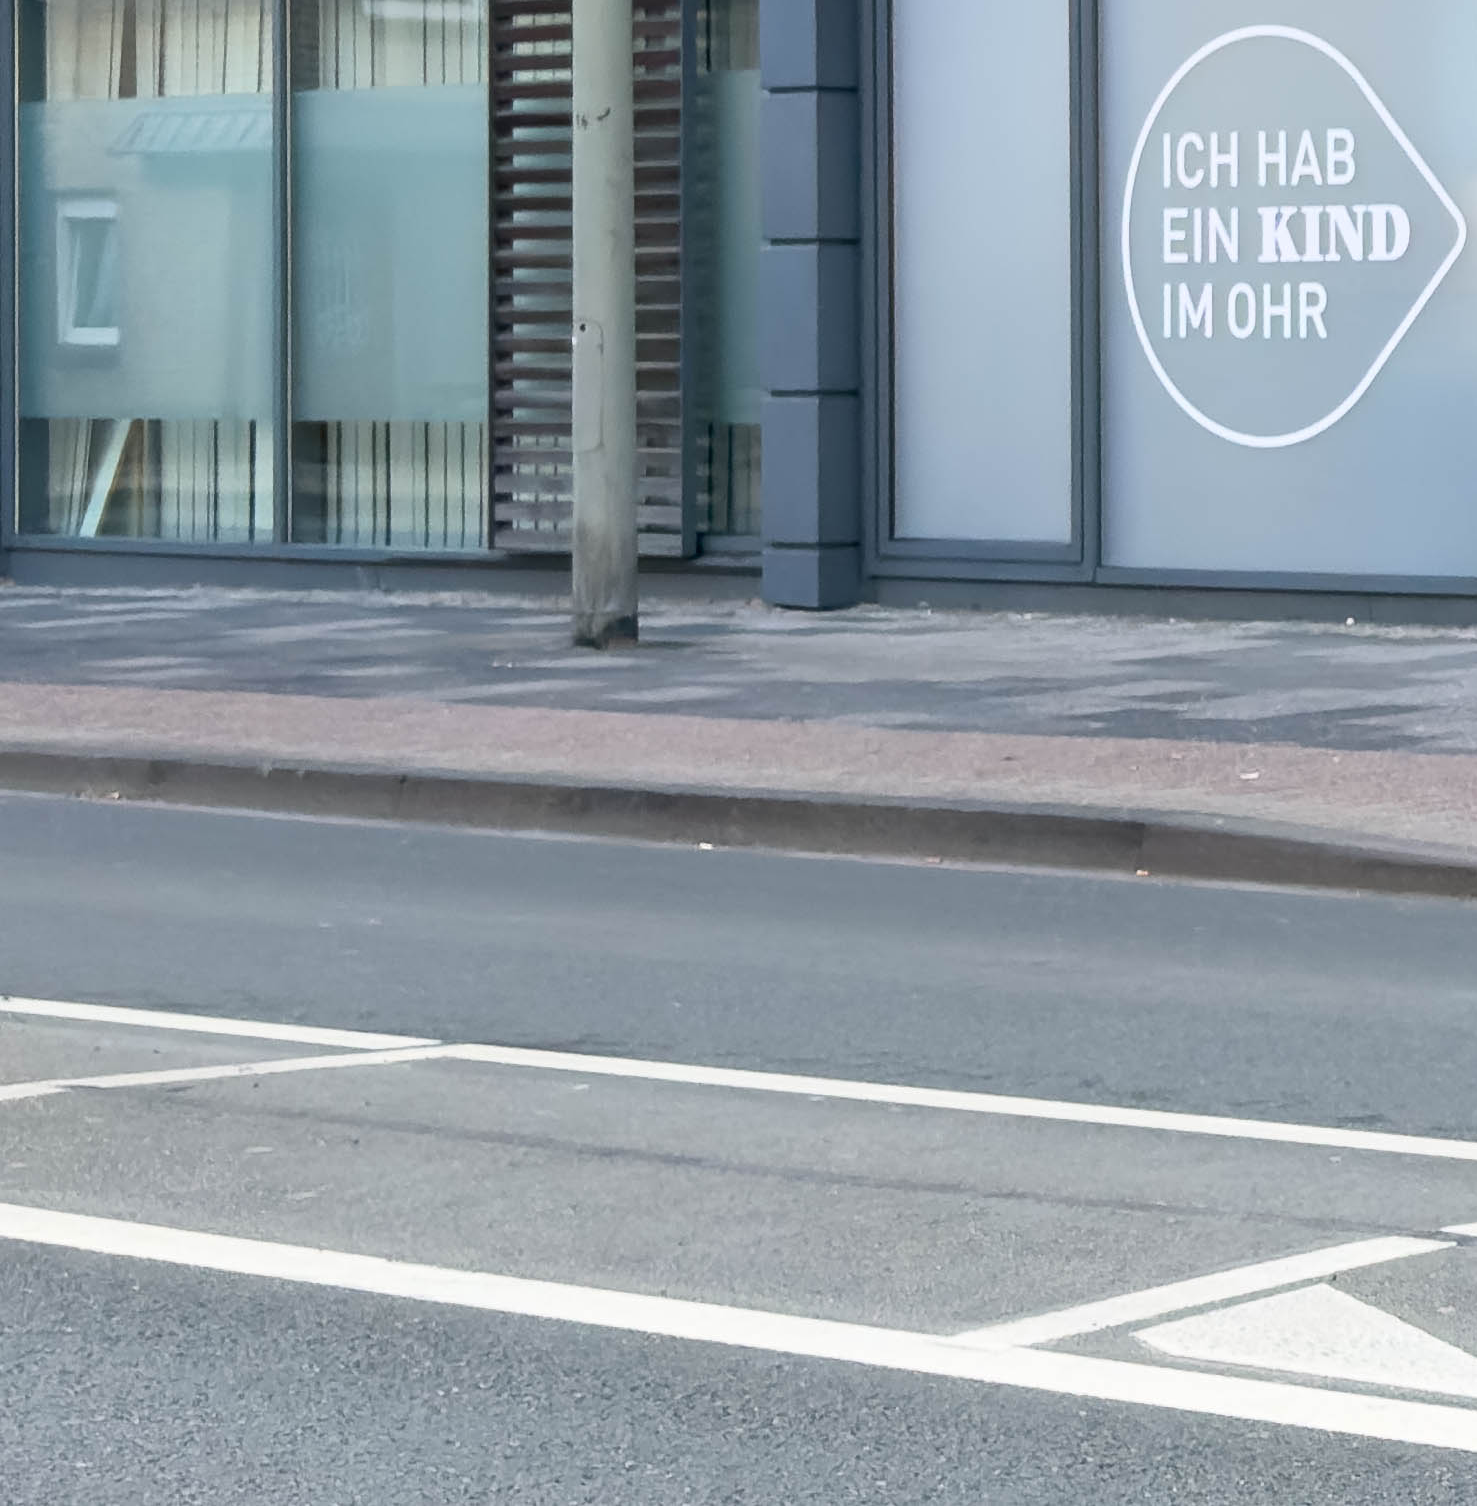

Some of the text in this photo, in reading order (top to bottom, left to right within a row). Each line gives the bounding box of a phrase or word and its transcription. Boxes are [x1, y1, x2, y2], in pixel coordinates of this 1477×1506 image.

[1162, 128, 1356, 189] ICH HAB
[1162, 203, 1411, 266] EIN KIND
[1162, 280, 1330, 341] IM OHR
